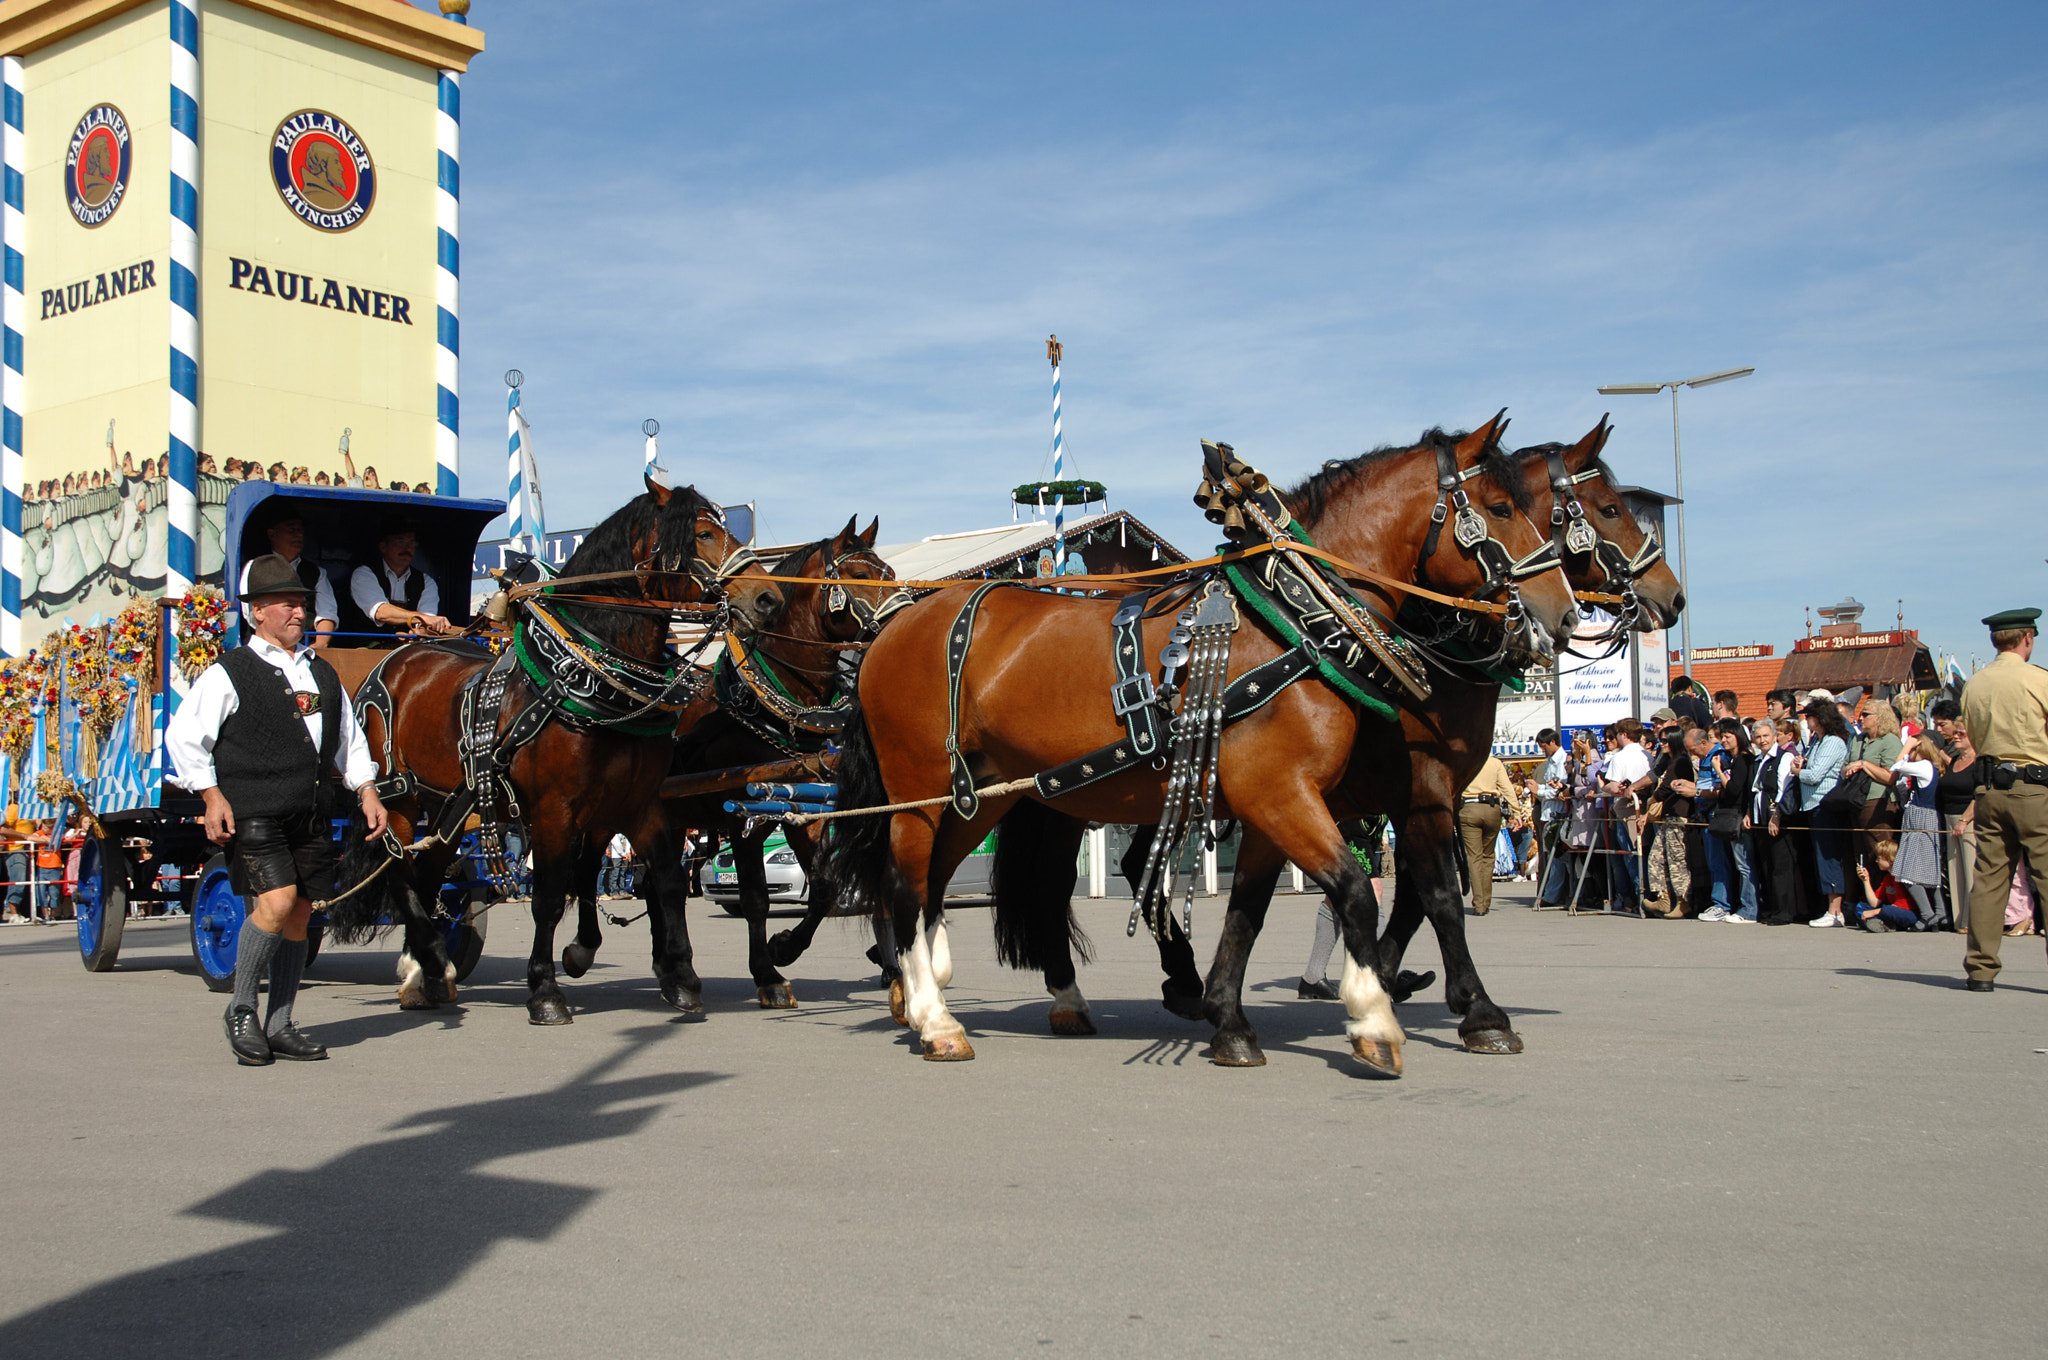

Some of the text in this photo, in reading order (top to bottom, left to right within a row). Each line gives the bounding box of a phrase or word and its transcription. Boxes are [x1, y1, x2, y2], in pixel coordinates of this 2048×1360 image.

[67, 107, 129, 167] PAULANER
[274, 112, 371, 174] PAULANER
[72, 181, 125, 224] MÜNCHEN
[281, 184, 366, 229] MÜNCHEN
[40, 259, 158, 321] PAULANER
[228, 256, 413, 326] PAULANER
[1809, 633, 1891, 650] Zur Bratwurst
[1513, 680, 1554, 694] PAT
[1564, 694, 1629, 705] Lackierarbeiten
[1602, 679, 1622, 689] und
